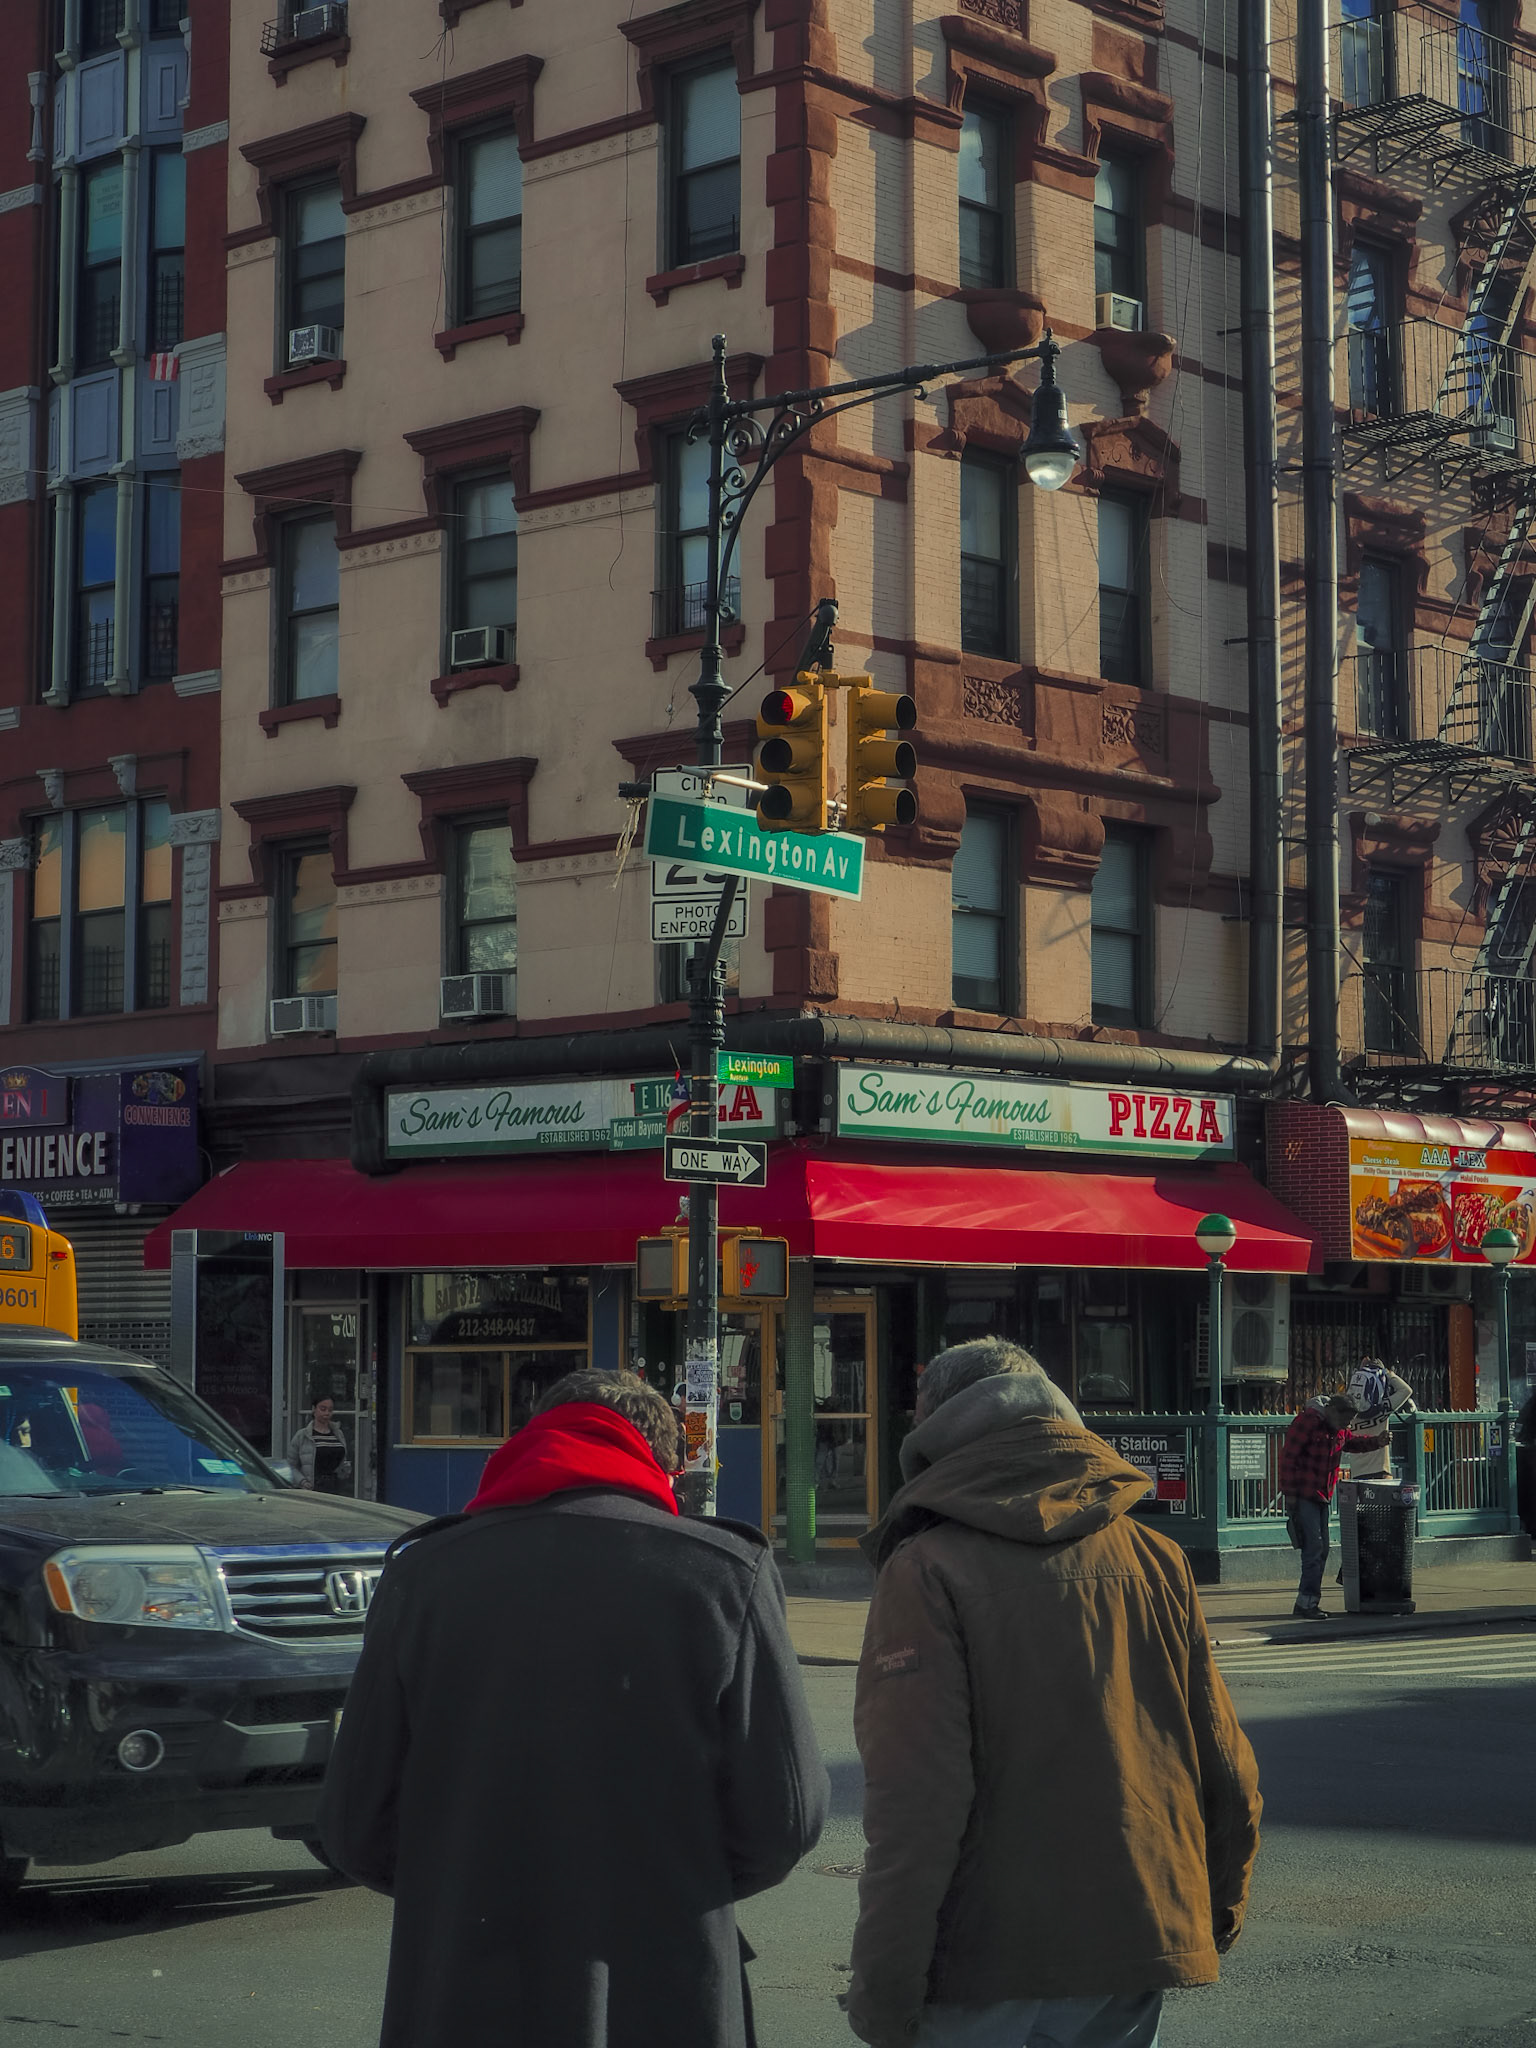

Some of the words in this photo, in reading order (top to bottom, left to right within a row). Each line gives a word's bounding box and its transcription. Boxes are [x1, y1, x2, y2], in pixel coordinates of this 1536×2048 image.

[677, 815, 816, 873] Lexington
[822, 846, 849, 880] Av
[660, 920, 737, 934] ENFORCD
[728, 1055, 780, 1078] Lexington
[0, 1090, 32, 1119] EN
[642, 1085, 649, 1109] E
[655, 1084, 672, 1108] 116
[945, 1081, 1052, 1124] Famous
[124, 1105, 191, 1127] CONVENIENCE
[485, 1091, 586, 1131] Famous
[1108, 1092, 1224, 1143] PIZZA
[540, 1130, 590, 1144] ESTABLISHED
[591, 1129, 611, 1142] 1962
[613, 1121, 636, 1138] Kristal
[1013, 1131, 1058, 1144] ESTABLISHED
[1060, 1132, 1078, 1145] 1962
[1, 1131, 107, 1180] ENIENCE
[680, 1152, 709, 1169] ONE
[722, 1154, 751, 1172] WAY
[1420, 1147, 1451, 1167] AAA
[1474, 1175, 1489, 1183] Foods
[50, 1190, 74, 1201] COFFEE
[81, 1189, 93, 1200] TEA
[99, 1188, 113, 1199] ATM
[244, 1232, 273, 1242] LinkNYC
[458, 1318, 536, 1337] 212-348-9437
[1120, 1436, 1168, 1451] Station
[1123, 1453, 1152, 1464] Bronx
